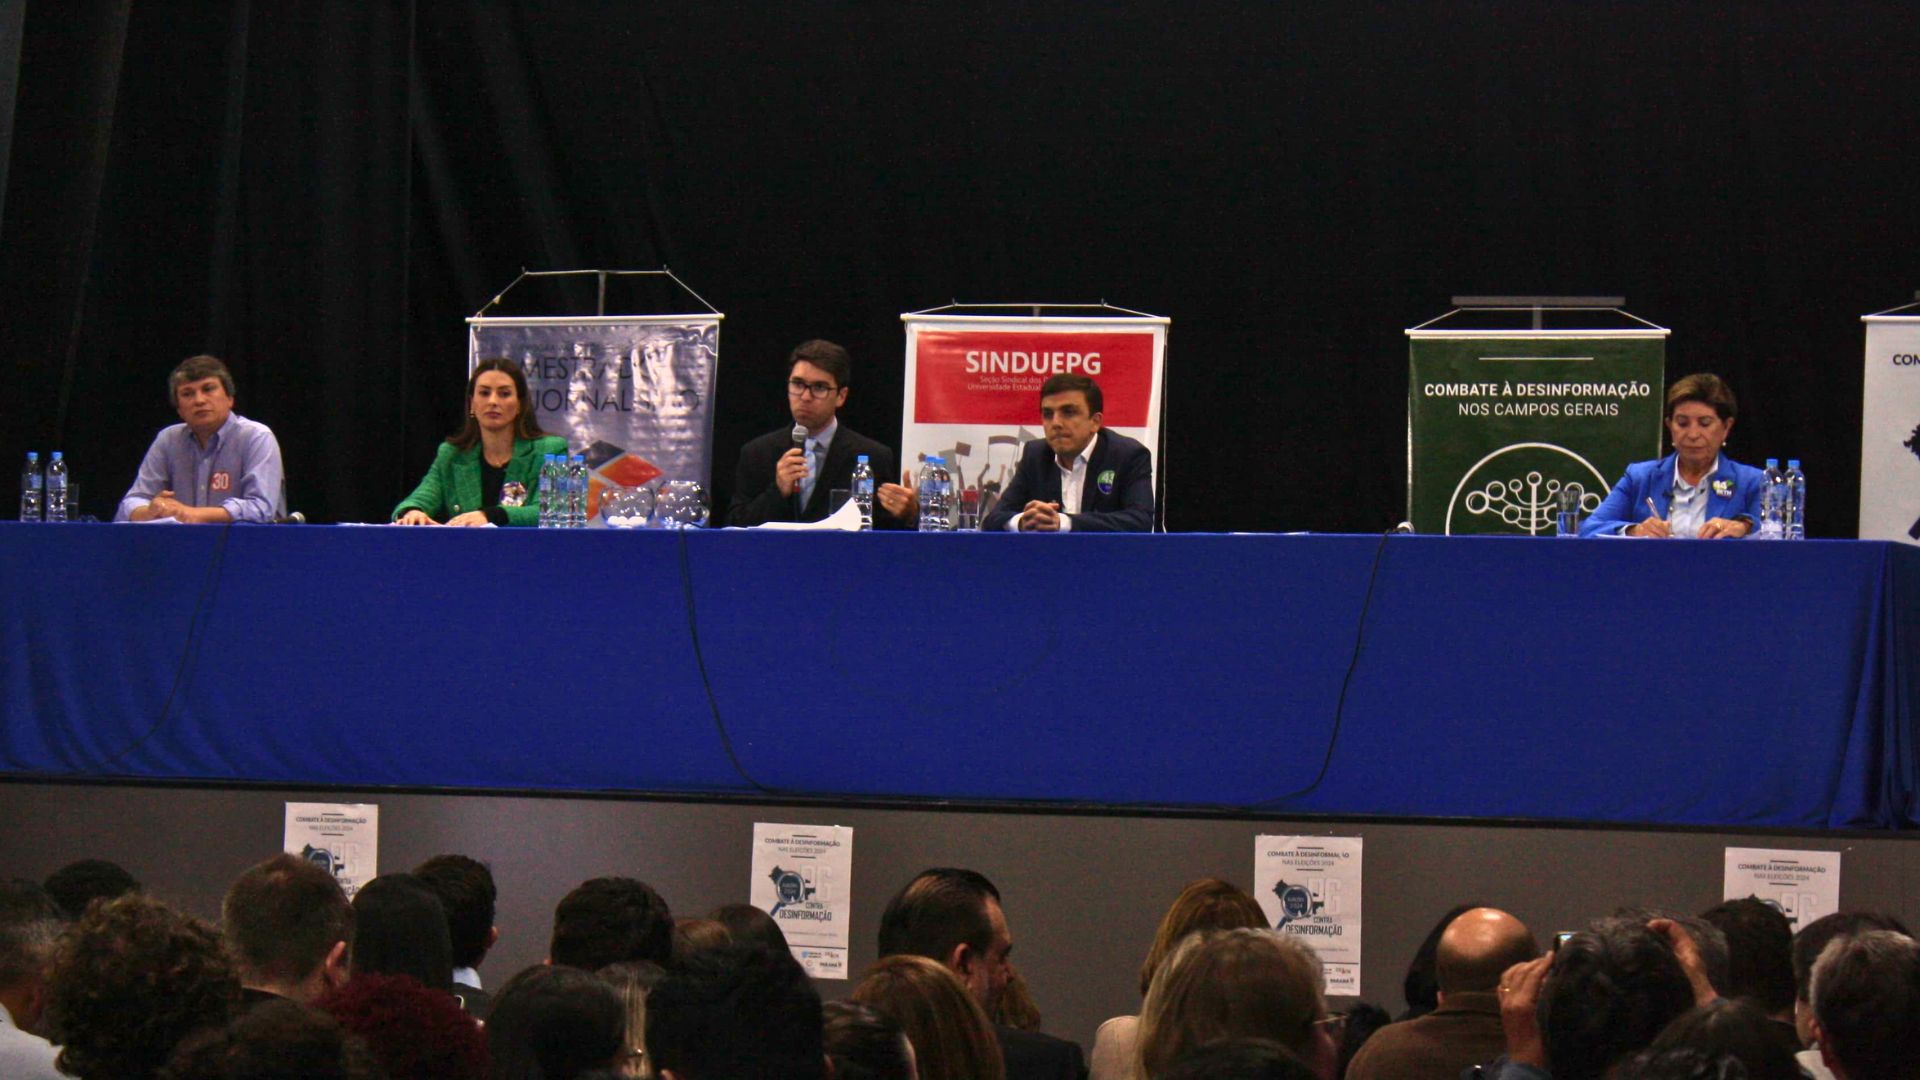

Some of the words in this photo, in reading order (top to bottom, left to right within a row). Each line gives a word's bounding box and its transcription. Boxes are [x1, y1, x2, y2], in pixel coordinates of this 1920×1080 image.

[965, 351, 1101, 375] SINDUEPG
[967, 384, 1011, 392] Universidade
[1012, 384, 1041, 392] Estadual
[1424, 383, 1498, 397] COMBATE
[1502, 380, 1513, 397] À
[1516, 381, 1651, 399] DESINFORMAÇÃO
[1458, 403, 1489, 416] NOS
[1494, 403, 1560, 416] CAMPOS
[1564, 403, 1619, 416] GERAIS
[211, 473, 230, 490] 30
[779, 908, 833, 923] DESINFORMAÇÃO
[1313, 916, 1333, 924] CONTRA
[1286, 924, 1343, 938] DESINFORMAÇÃO
